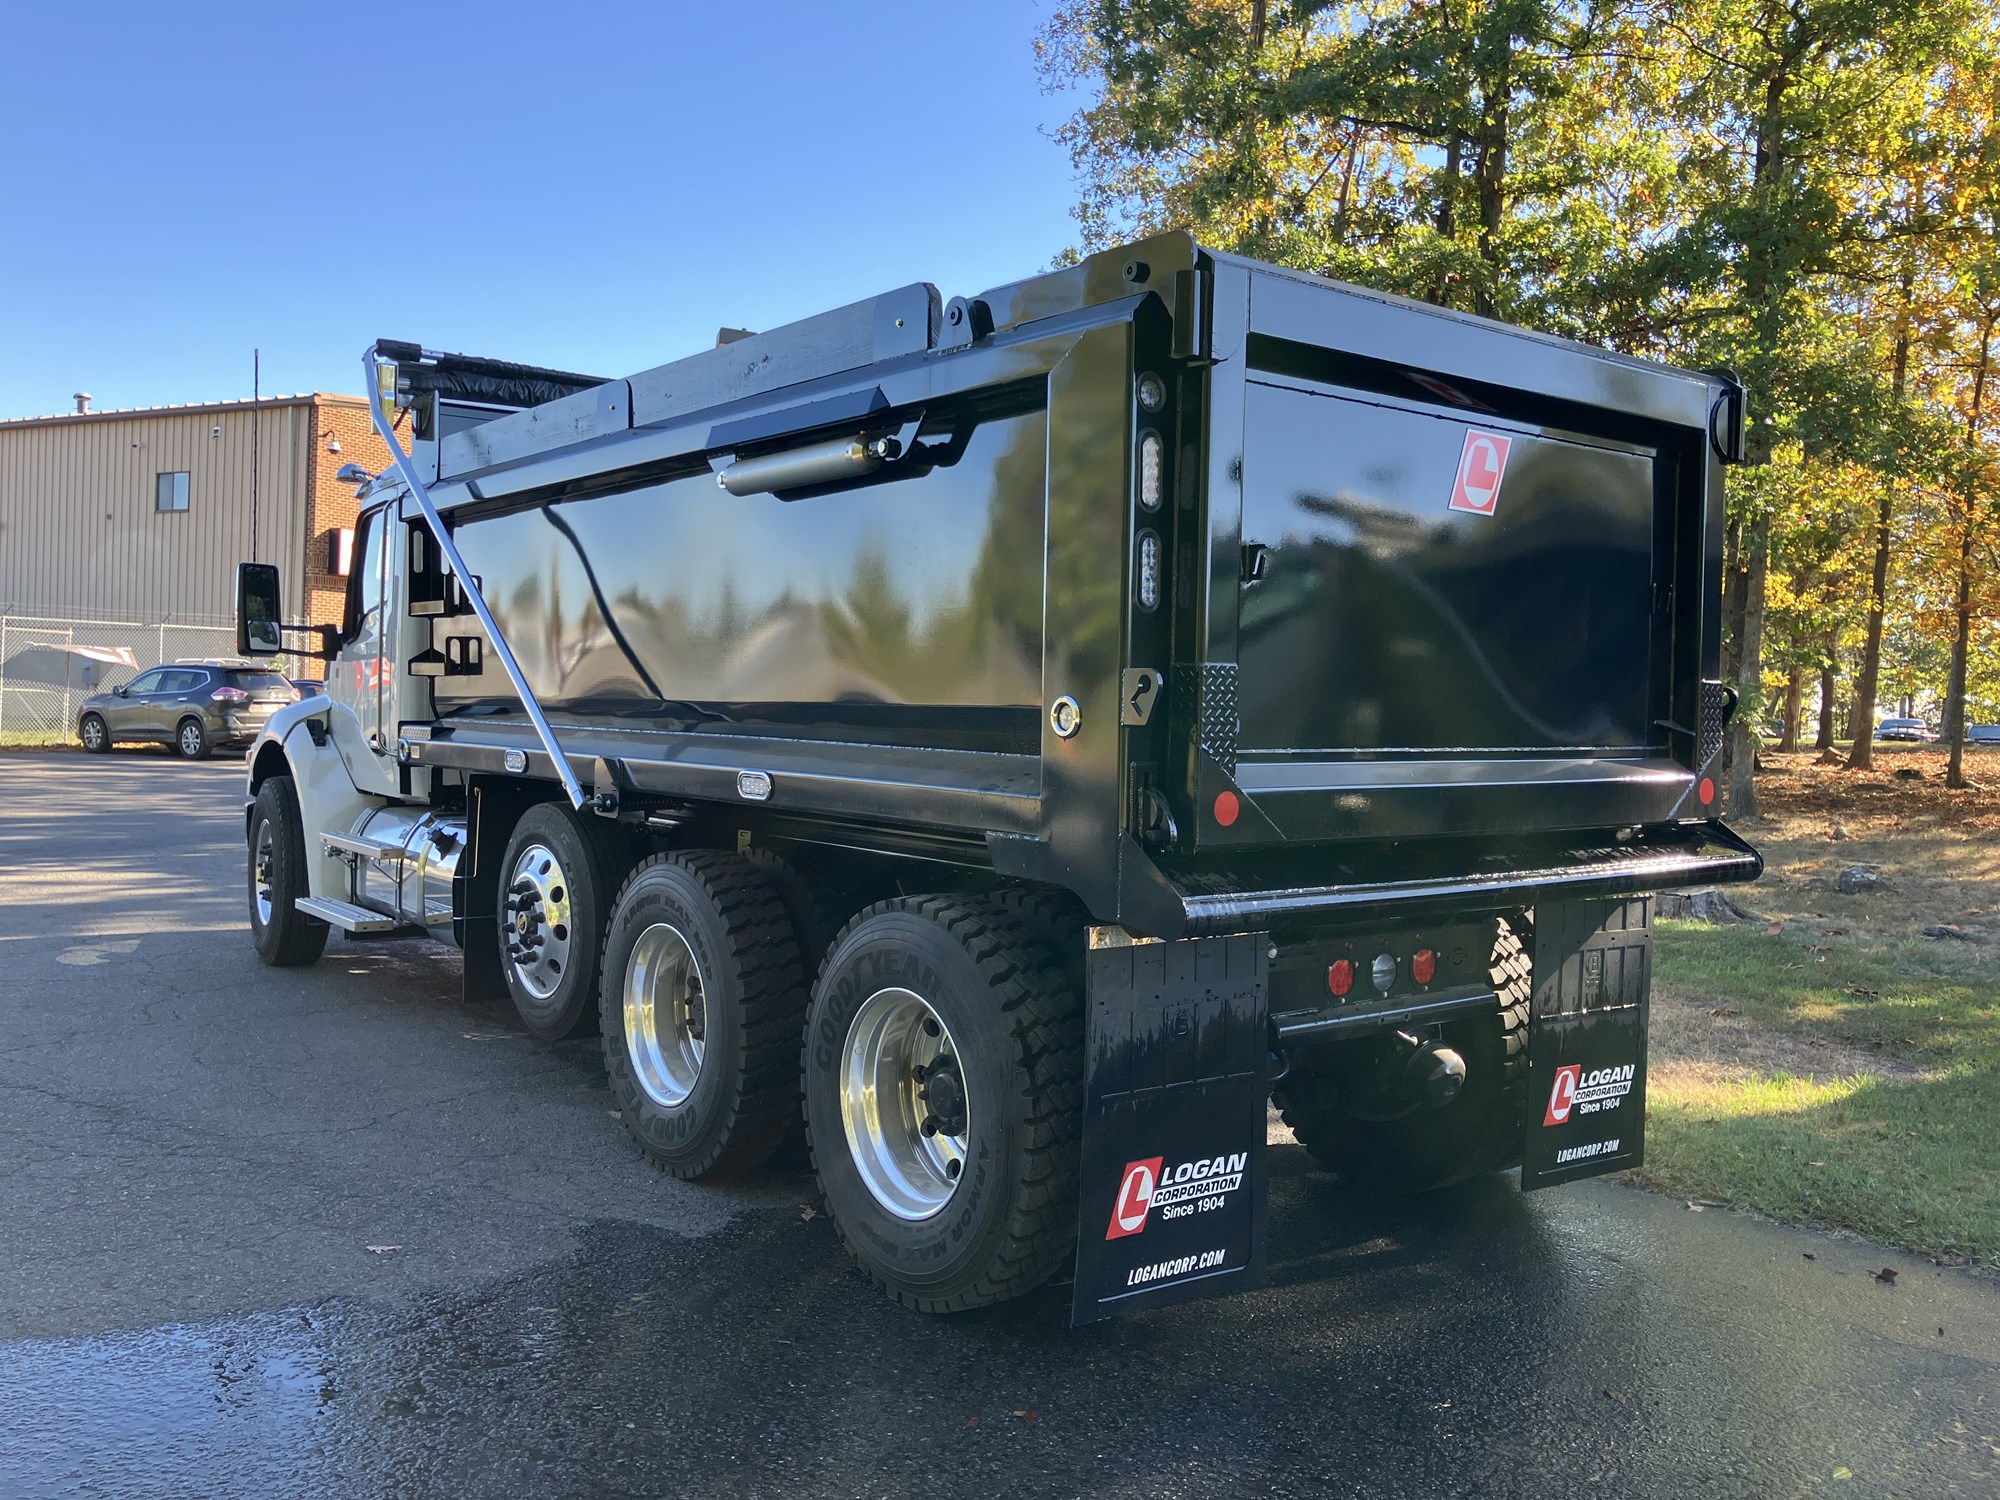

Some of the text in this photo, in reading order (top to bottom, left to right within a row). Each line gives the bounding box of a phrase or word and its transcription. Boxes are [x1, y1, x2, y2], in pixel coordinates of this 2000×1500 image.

[1465, 444, 1497, 491] L
[623, 893, 661, 931] ARMOR
[665, 895, 693, 929] MAX
[815, 949, 942, 1073] GOODYEAR
[609, 1035, 697, 1142] GOODYEAR
[1574, 1082, 1629, 1101] CORPORATION
[1579, 1064, 1635, 1089] LOGAN
[1579, 1097, 1621, 1115] Since 1904
[1556, 1138, 1620, 1164] LOGANCORP.COM
[1160, 1152, 1247, 1186] LOGAN
[951, 1137, 989, 1242] ARMOR
[1154, 1175, 1239, 1204] CORPORATION
[1162, 1195, 1225, 1221] Since 1904
[1126, 1248, 1226, 1286] LOGANCORP.COM
